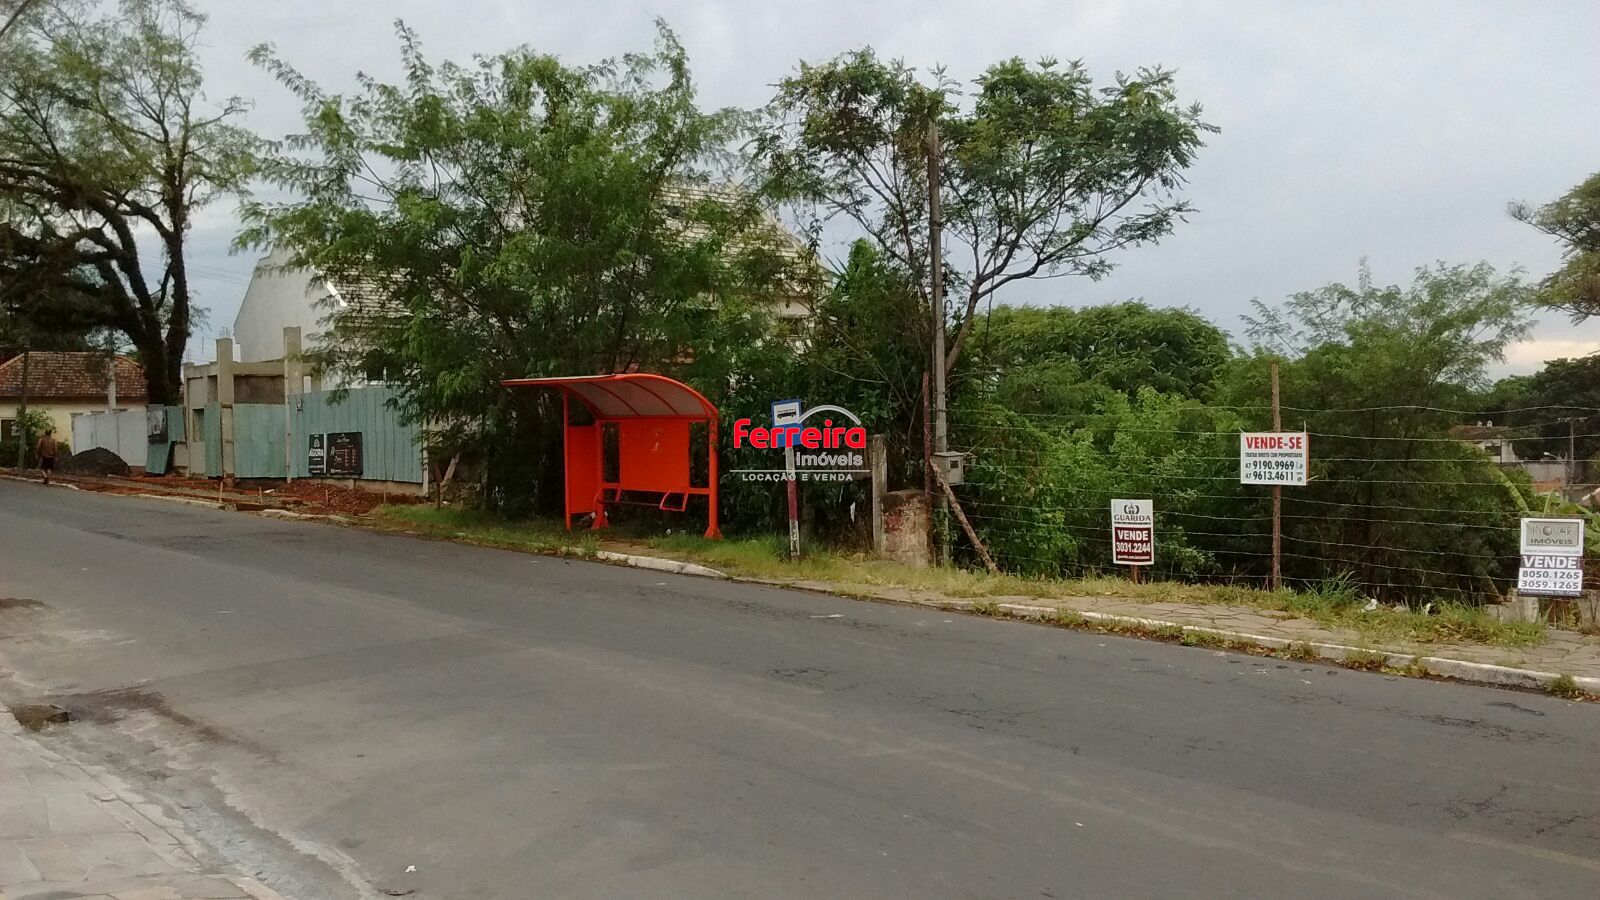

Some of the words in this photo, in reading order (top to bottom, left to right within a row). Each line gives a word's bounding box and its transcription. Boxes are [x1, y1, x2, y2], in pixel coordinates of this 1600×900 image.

[1246, 437, 1302, 449] VENDE-SE
[1252, 460, 1295, 470] 9190.9969
[1252, 470, 1294, 481] 9613.4611
[1117, 530, 1148, 540] VENDE
[1116, 542, 1151, 553] 3031.2244
[1522, 555, 1578, 569] VENDE
[1522, 570, 1580, 580] 8050.1265
[1521, 580, 1579, 590] 3059.1265
